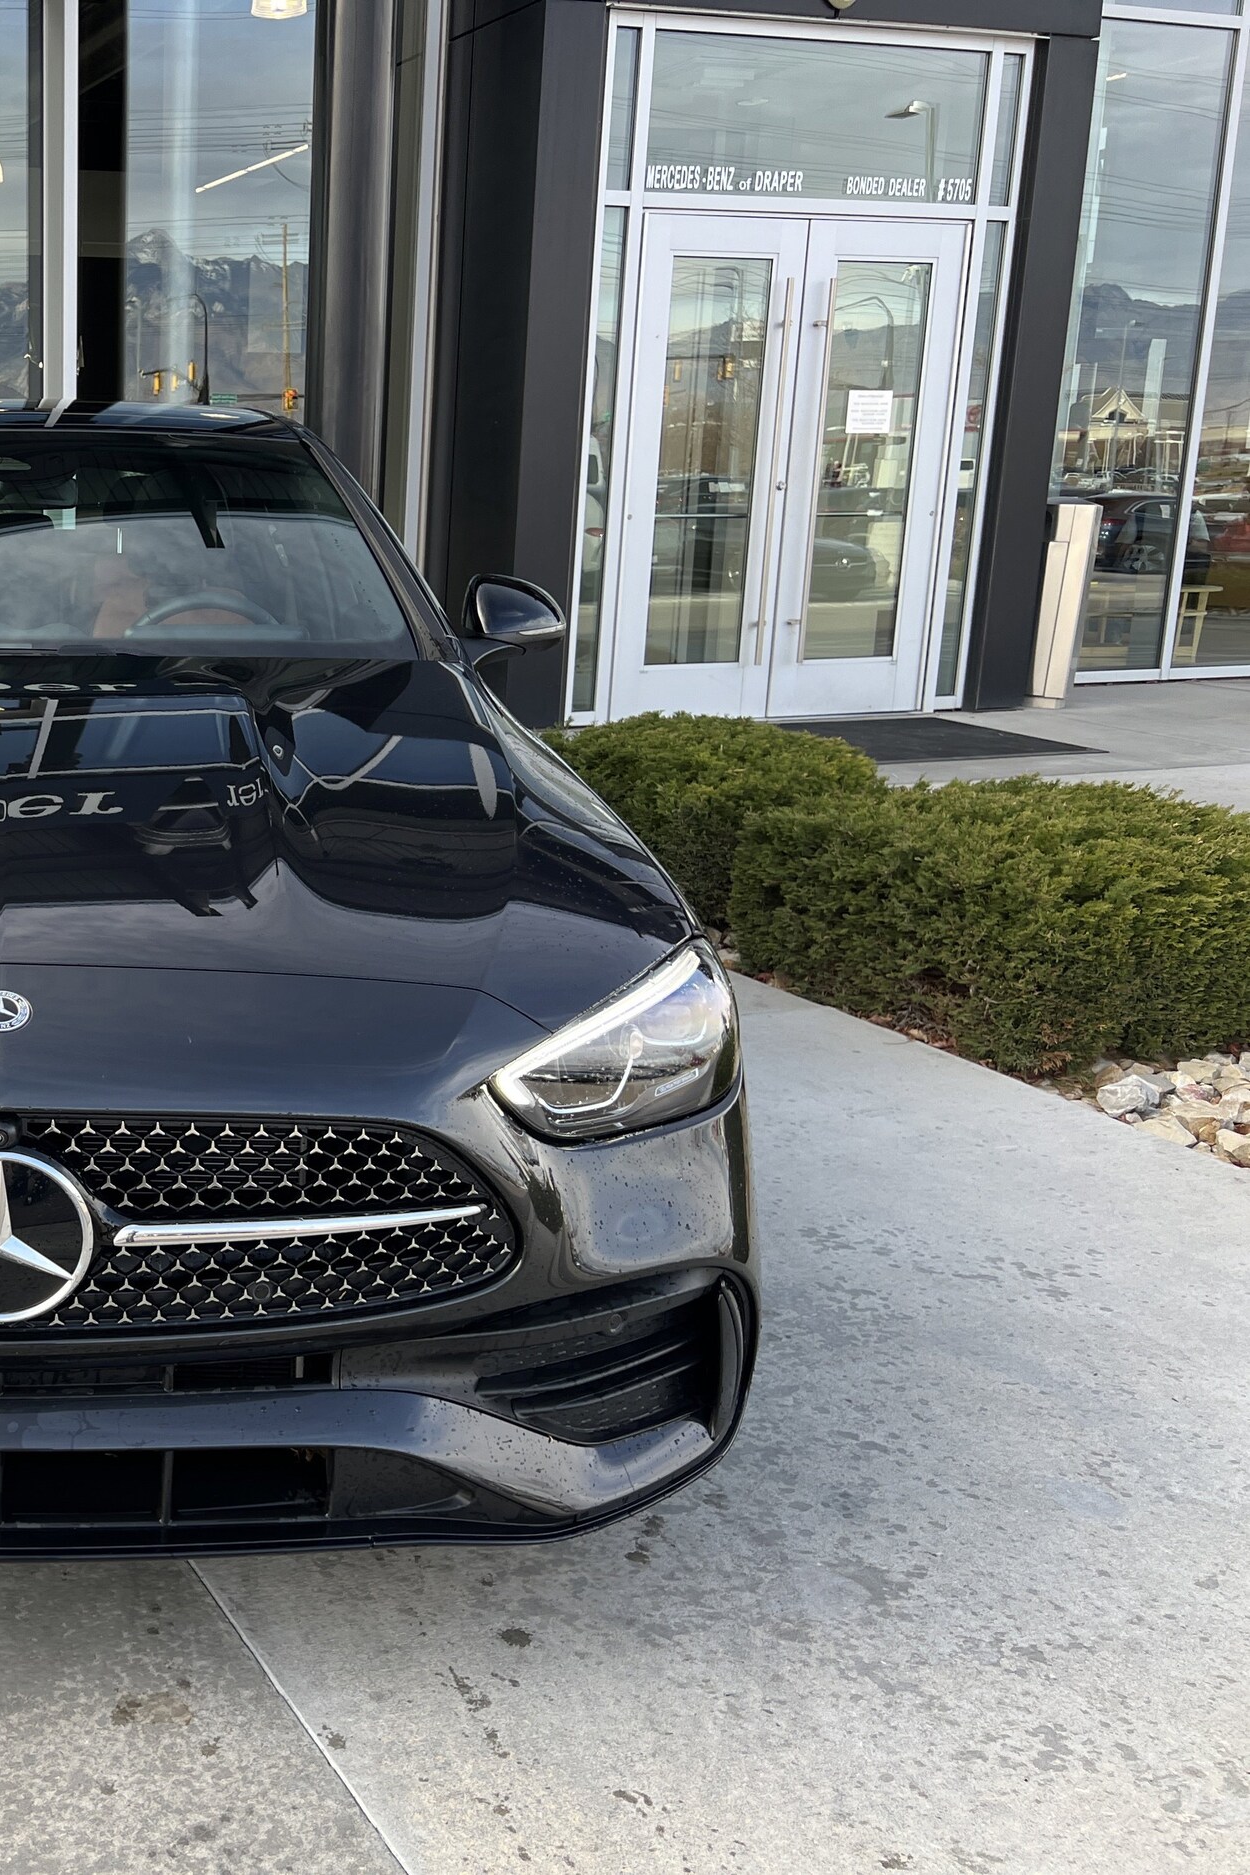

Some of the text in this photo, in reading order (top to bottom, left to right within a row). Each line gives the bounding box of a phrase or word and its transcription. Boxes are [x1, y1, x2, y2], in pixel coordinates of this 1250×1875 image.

[738, 177, 752, 191] of
[754, 170, 804, 192] DRAPER
[846, 176, 885, 195] BONDED
[888, 178, 926, 197] DEALER
